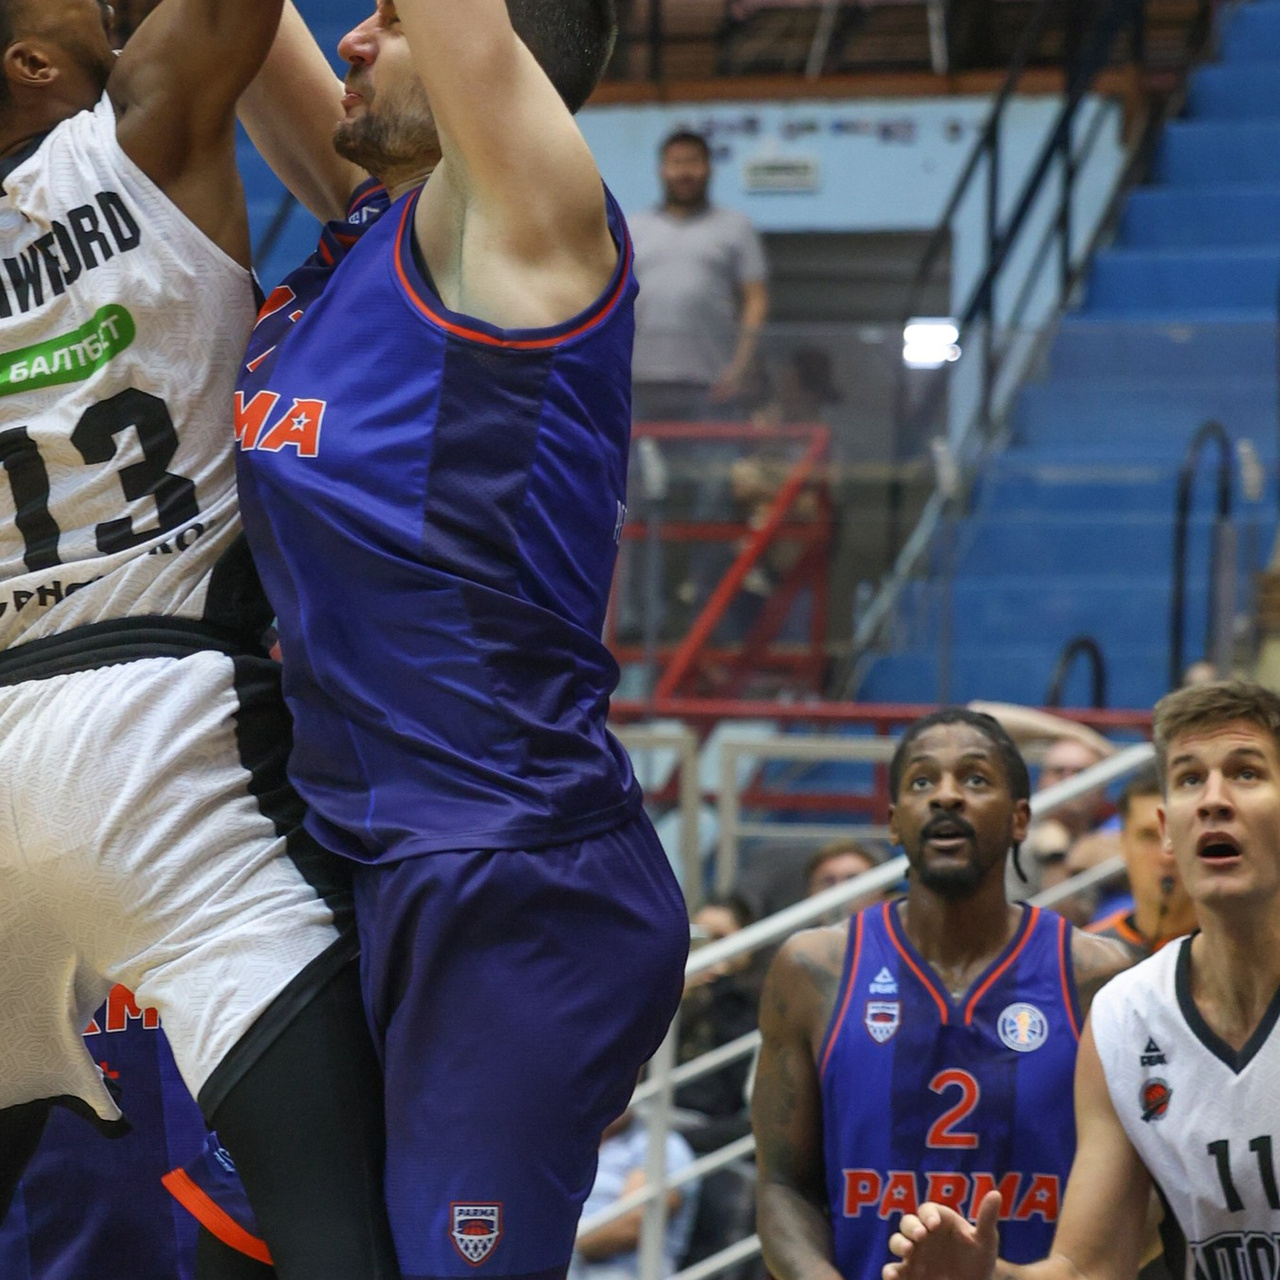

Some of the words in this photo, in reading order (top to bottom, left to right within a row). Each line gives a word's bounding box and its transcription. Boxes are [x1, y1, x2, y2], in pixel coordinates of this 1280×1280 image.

[234, 390, 326, 458] MA
[926, 1068, 980, 1149] 2
[843, 1168, 1060, 1223] PARMA
[1207, 1135, 1280, 1213] 11
